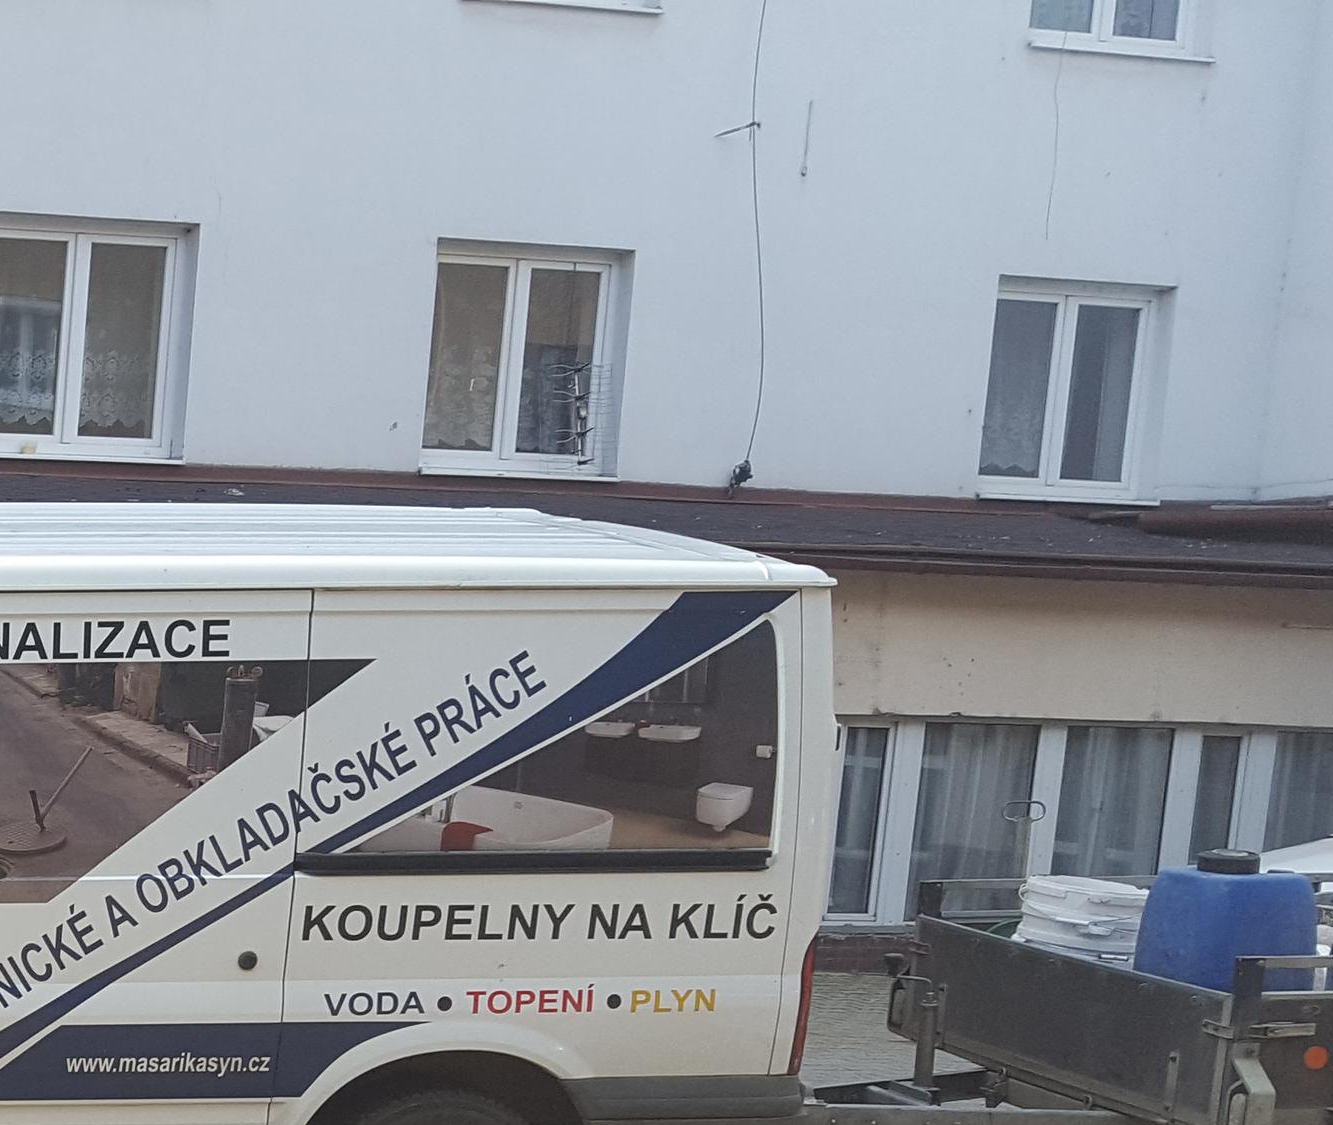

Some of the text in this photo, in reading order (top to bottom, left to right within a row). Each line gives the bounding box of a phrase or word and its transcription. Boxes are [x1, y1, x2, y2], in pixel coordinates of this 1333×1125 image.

[104, 895, 139, 938] A
[136, 722, 418, 913] OBKLADAČSKÉ
[414, 650, 547, 757] PRÁCE
[301, 893, 779, 941] KOUPELNY NA KLÍČ
[324, 984, 717, 1016] VODA TOPENÍ PLYN
[65, 1052, 271, 1079] www.masarikasyn.cz
